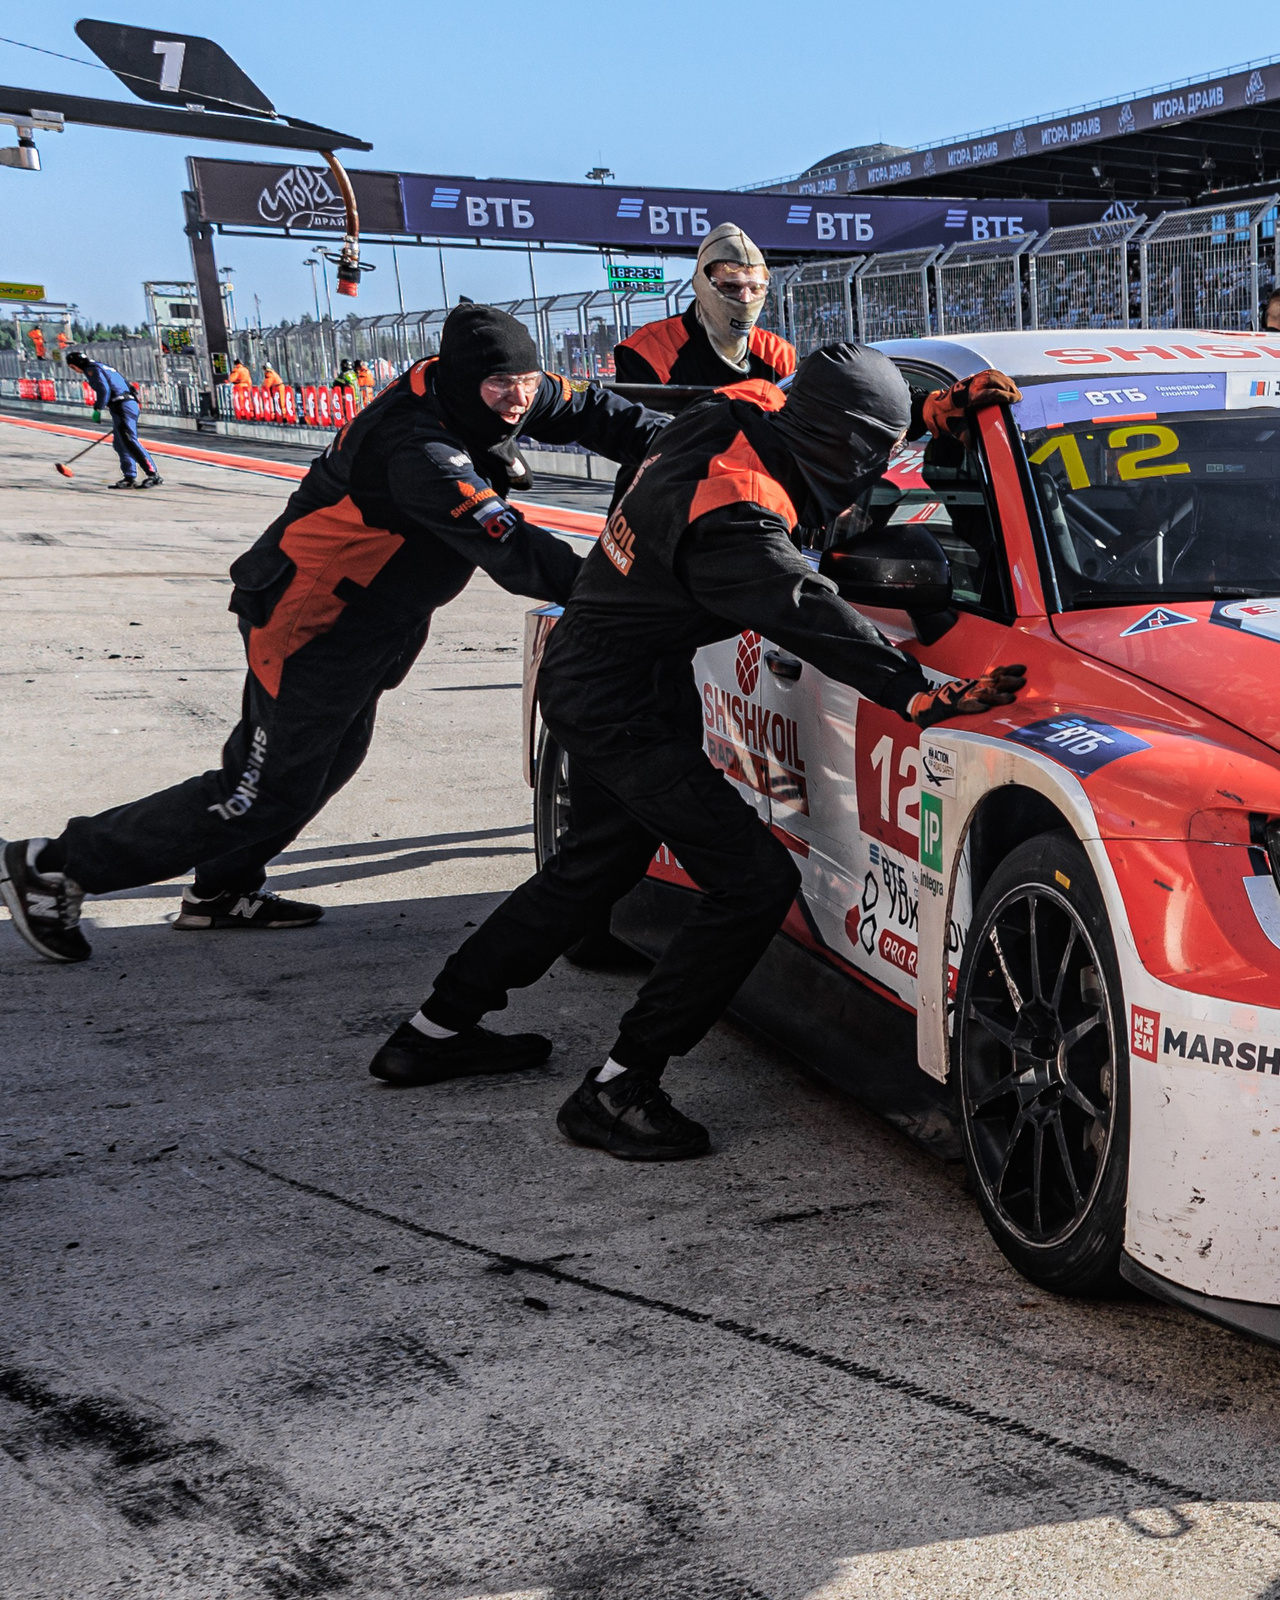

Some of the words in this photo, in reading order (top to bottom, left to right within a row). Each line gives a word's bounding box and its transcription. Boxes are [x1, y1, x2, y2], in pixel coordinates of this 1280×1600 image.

[152, 41, 186, 92] 1
[1153, 97, 1185, 120] ИГОРА
[314, 216, 345, 227] ДРАЙ
[466, 196, 535, 229] ВТБ
[648, 206, 711, 236] ВТБ
[816, 212, 875, 242] ВТБ
[972, 216, 1025, 243] ВТБ
[1084, 388, 1148, 406] ВТБ
[1028, 424, 1191, 490] 12
[602, 530, 628, 570] EAM
[703, 682, 806, 773] SHISHKOIL
[1044, 725, 1116, 756] ВТБ
[869, 734, 921, 839] 12
[924, 808, 940, 856] IP
[920, 868, 944, 897] integra
[883, 936, 905, 966] PRO
